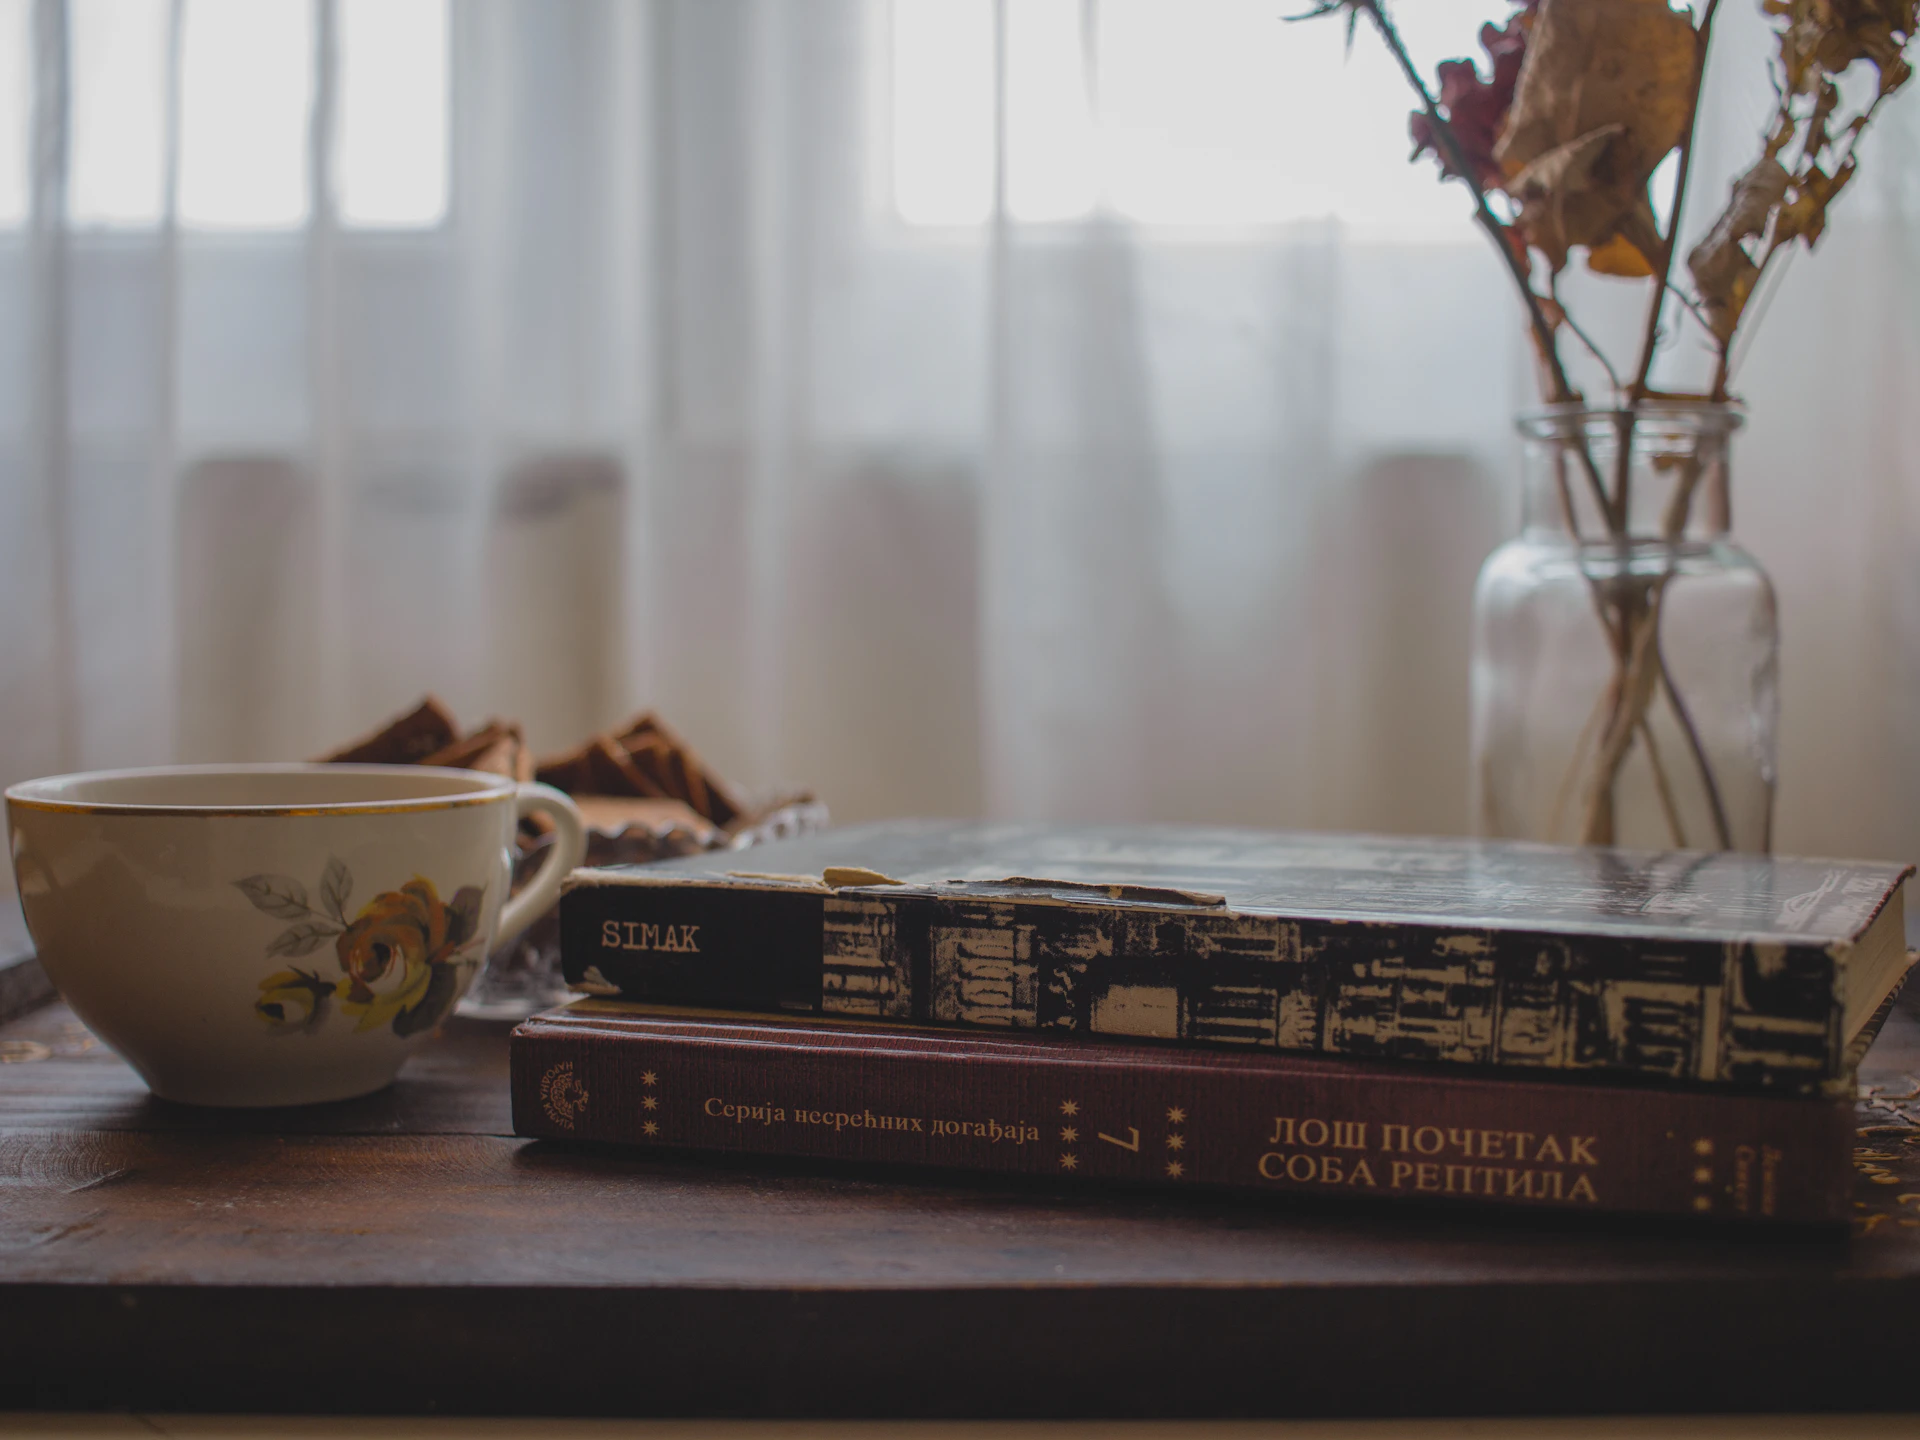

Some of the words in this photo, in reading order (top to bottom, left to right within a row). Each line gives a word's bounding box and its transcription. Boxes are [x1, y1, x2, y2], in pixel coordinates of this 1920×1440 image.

[601, 919, 701, 953] SIMAK
[704, 1096, 785, 1126] Серија
[794, 1106, 924, 1132] несрећних
[931, 1118, 1040, 1145] догађаја
[1269, 1116, 1368, 1150] ЛОШ
[1381, 1122, 1599, 1166] ПОЧЕТАК
[1257, 1151, 1378, 1188] СОБА
[1389, 1160, 1599, 1203] РЕПТИЛА
